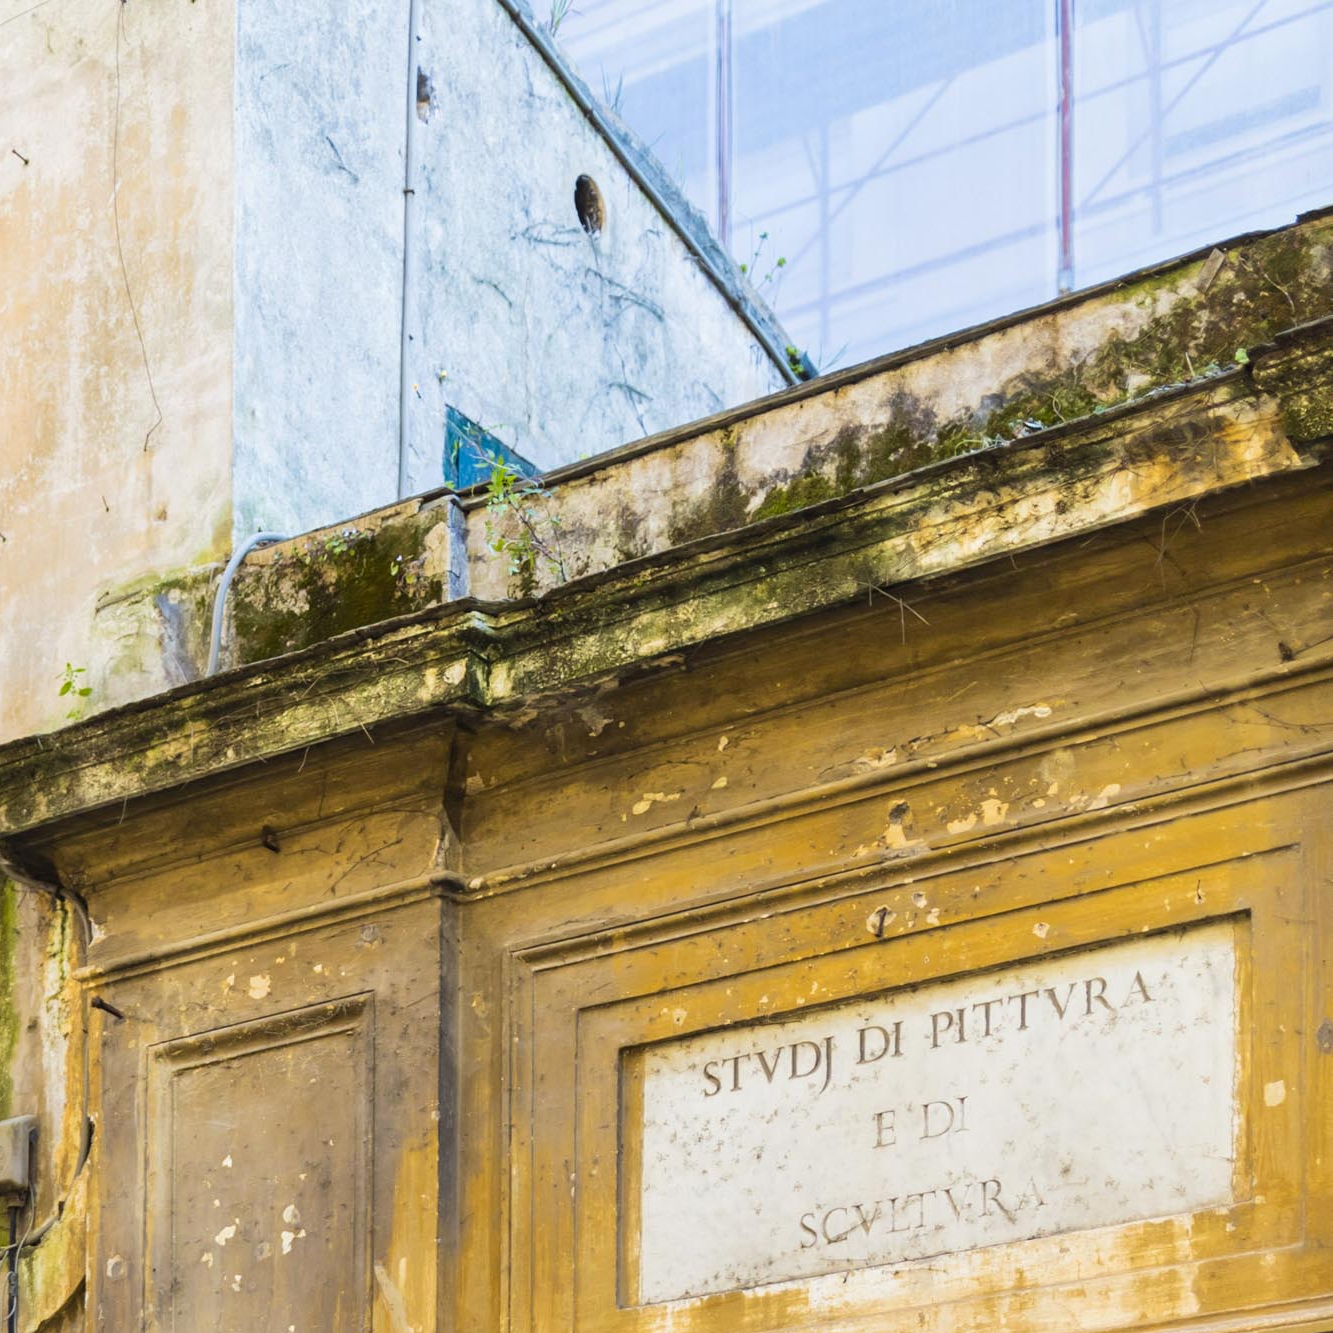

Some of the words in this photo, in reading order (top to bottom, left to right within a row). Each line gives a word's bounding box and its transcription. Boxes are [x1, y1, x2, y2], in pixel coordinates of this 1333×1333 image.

[856, 1020, 904, 1065] DI
[930, 970, 1155, 1049] PITTVRA
[872, 1109, 898, 1149] E
[919, 1096, 969, 1140] DI
